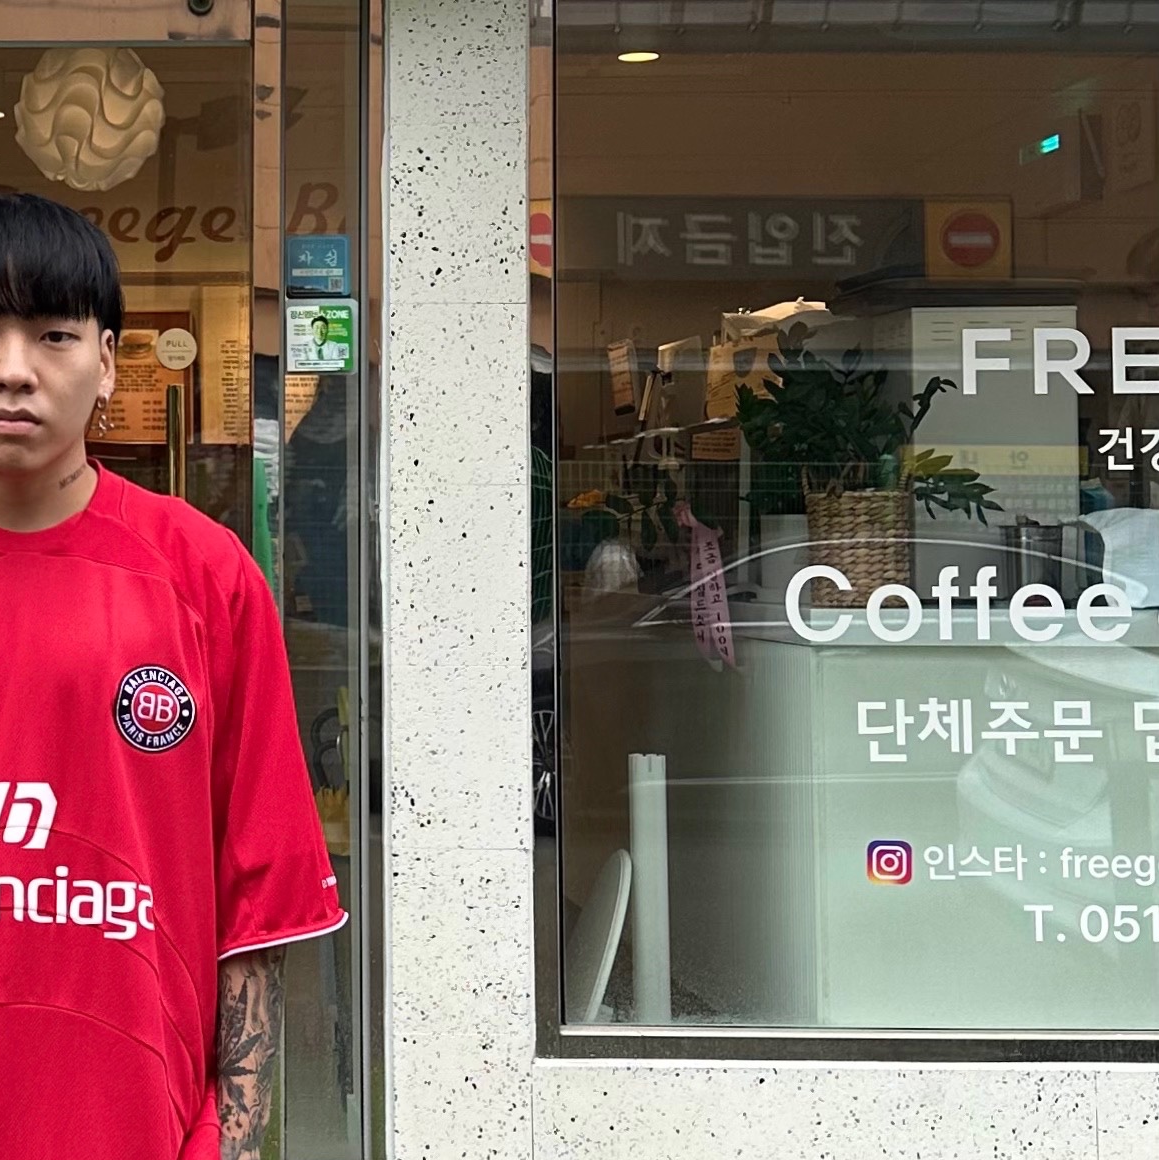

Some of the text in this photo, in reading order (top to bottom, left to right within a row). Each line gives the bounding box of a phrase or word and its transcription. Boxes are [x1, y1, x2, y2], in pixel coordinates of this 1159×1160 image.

[785, 565, 1132, 642] Coffee
[124, 670, 189, 704] BALENCIAGA
[121, 713, 187, 747] PARIS FRANCE
[857, 697, 1103, 763] 단체주문
[923, 844, 1028, 881] 인스타
[1023, 904, 1159, 942] T. 051
